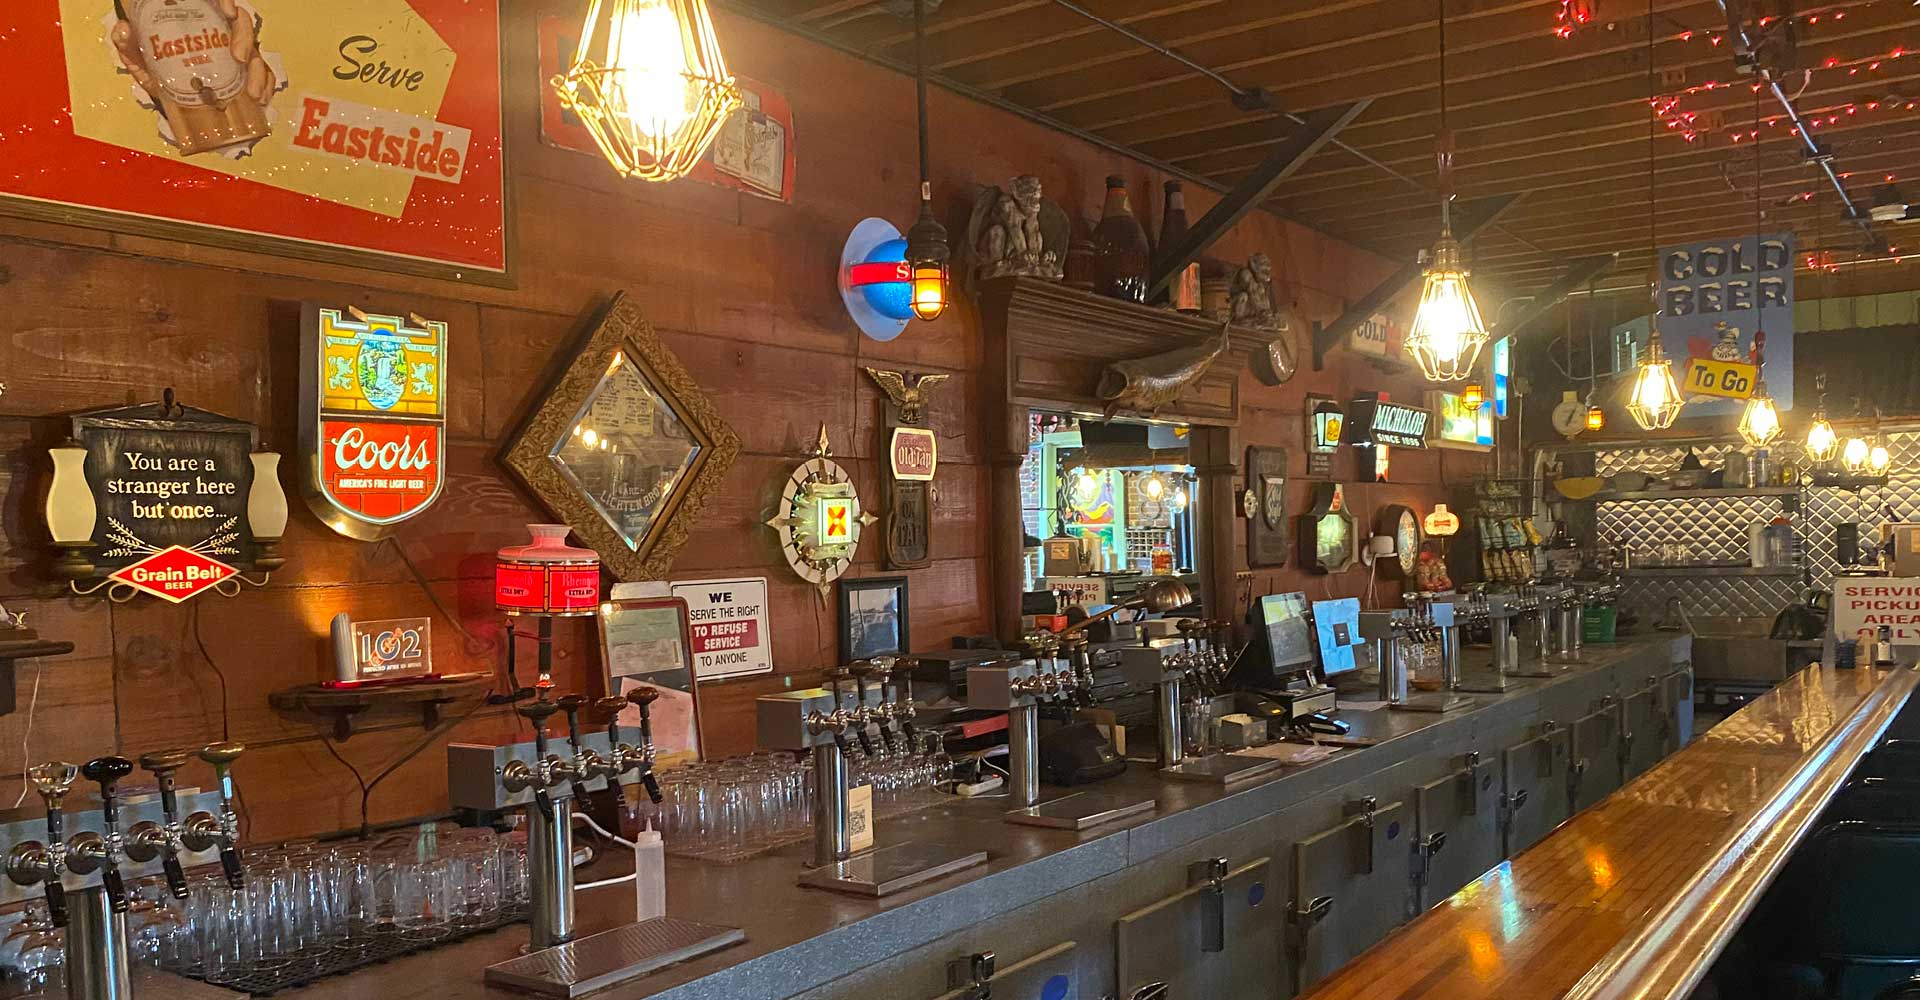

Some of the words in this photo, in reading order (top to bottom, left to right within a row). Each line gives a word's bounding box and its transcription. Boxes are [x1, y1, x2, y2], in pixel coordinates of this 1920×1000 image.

[150, 28, 230, 61] Eastside
[332, 35, 425, 92] Serve
[293, 97, 461, 178] Eastside
[1664, 239, 1789, 281] COLD
[1665, 276, 1788, 317] BEER
[1694, 365, 1716, 388] To
[1720, 369, 1748, 393] Go
[1372, 404, 1427, 436] MICHELOB
[1376, 433, 1401, 444] SINCE
[331, 427, 431, 470] Coors
[124, 452, 163, 471] You
[168, 458, 199, 471] are
[204, 459, 216, 471] a
[107, 478, 191, 499] stranger
[195, 476, 236, 495] here
[131, 500, 165, 519] but
[170, 504, 227, 519] once...
[131, 567, 184, 583] Grain
[186, 565, 222, 580] Belt
[164, 582, 193, 591] BEER
[709, 592, 733, 603] WE
[690, 609, 717, 620] SERVE
[719, 607, 735, 618] THE
[737, 605, 760, 617] RIGHT
[1864, 614, 1920, 624] AREA
[694, 626, 708, 638] TO
[711, 622, 748, 636] REFUSE
[704, 636, 741, 650] SERVICE
[701, 655, 712, 667] TO
[715, 652, 748, 665] ANYONE
